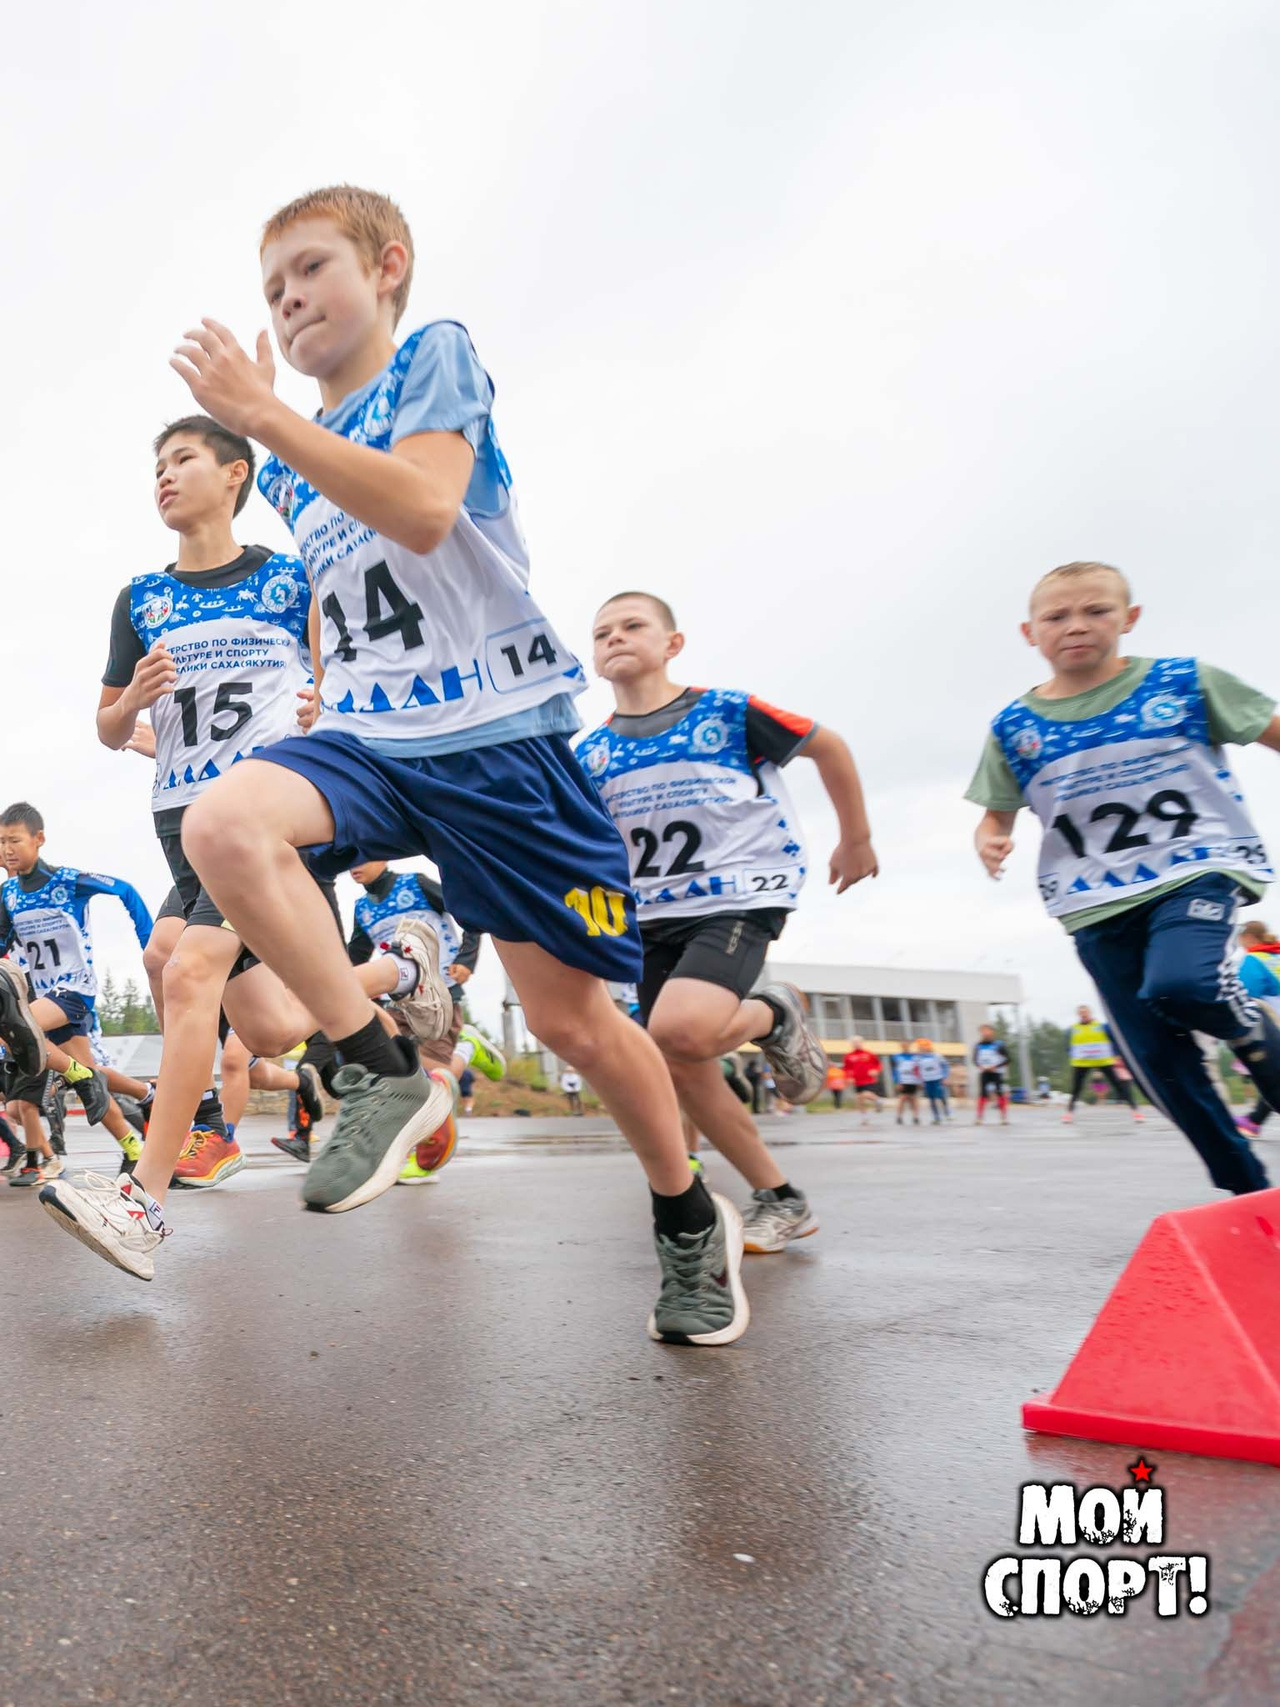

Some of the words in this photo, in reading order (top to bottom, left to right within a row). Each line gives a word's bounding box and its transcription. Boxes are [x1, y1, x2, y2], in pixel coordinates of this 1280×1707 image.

[330, 511, 345, 529] ПО
[337, 529, 347, 541] И
[322, 560, 424, 662] 14
[212, 638, 228, 647] ПО
[215, 650, 223, 658] И
[226, 648, 269, 658] СПОРТУ
[501, 633, 557, 677] 14
[174, 682, 252, 748] 15
[1052, 789, 1199, 859] 129
[630, 820, 705, 878] 22
[751, 874, 789, 892] 22
[27, 938, 61, 970] 21
